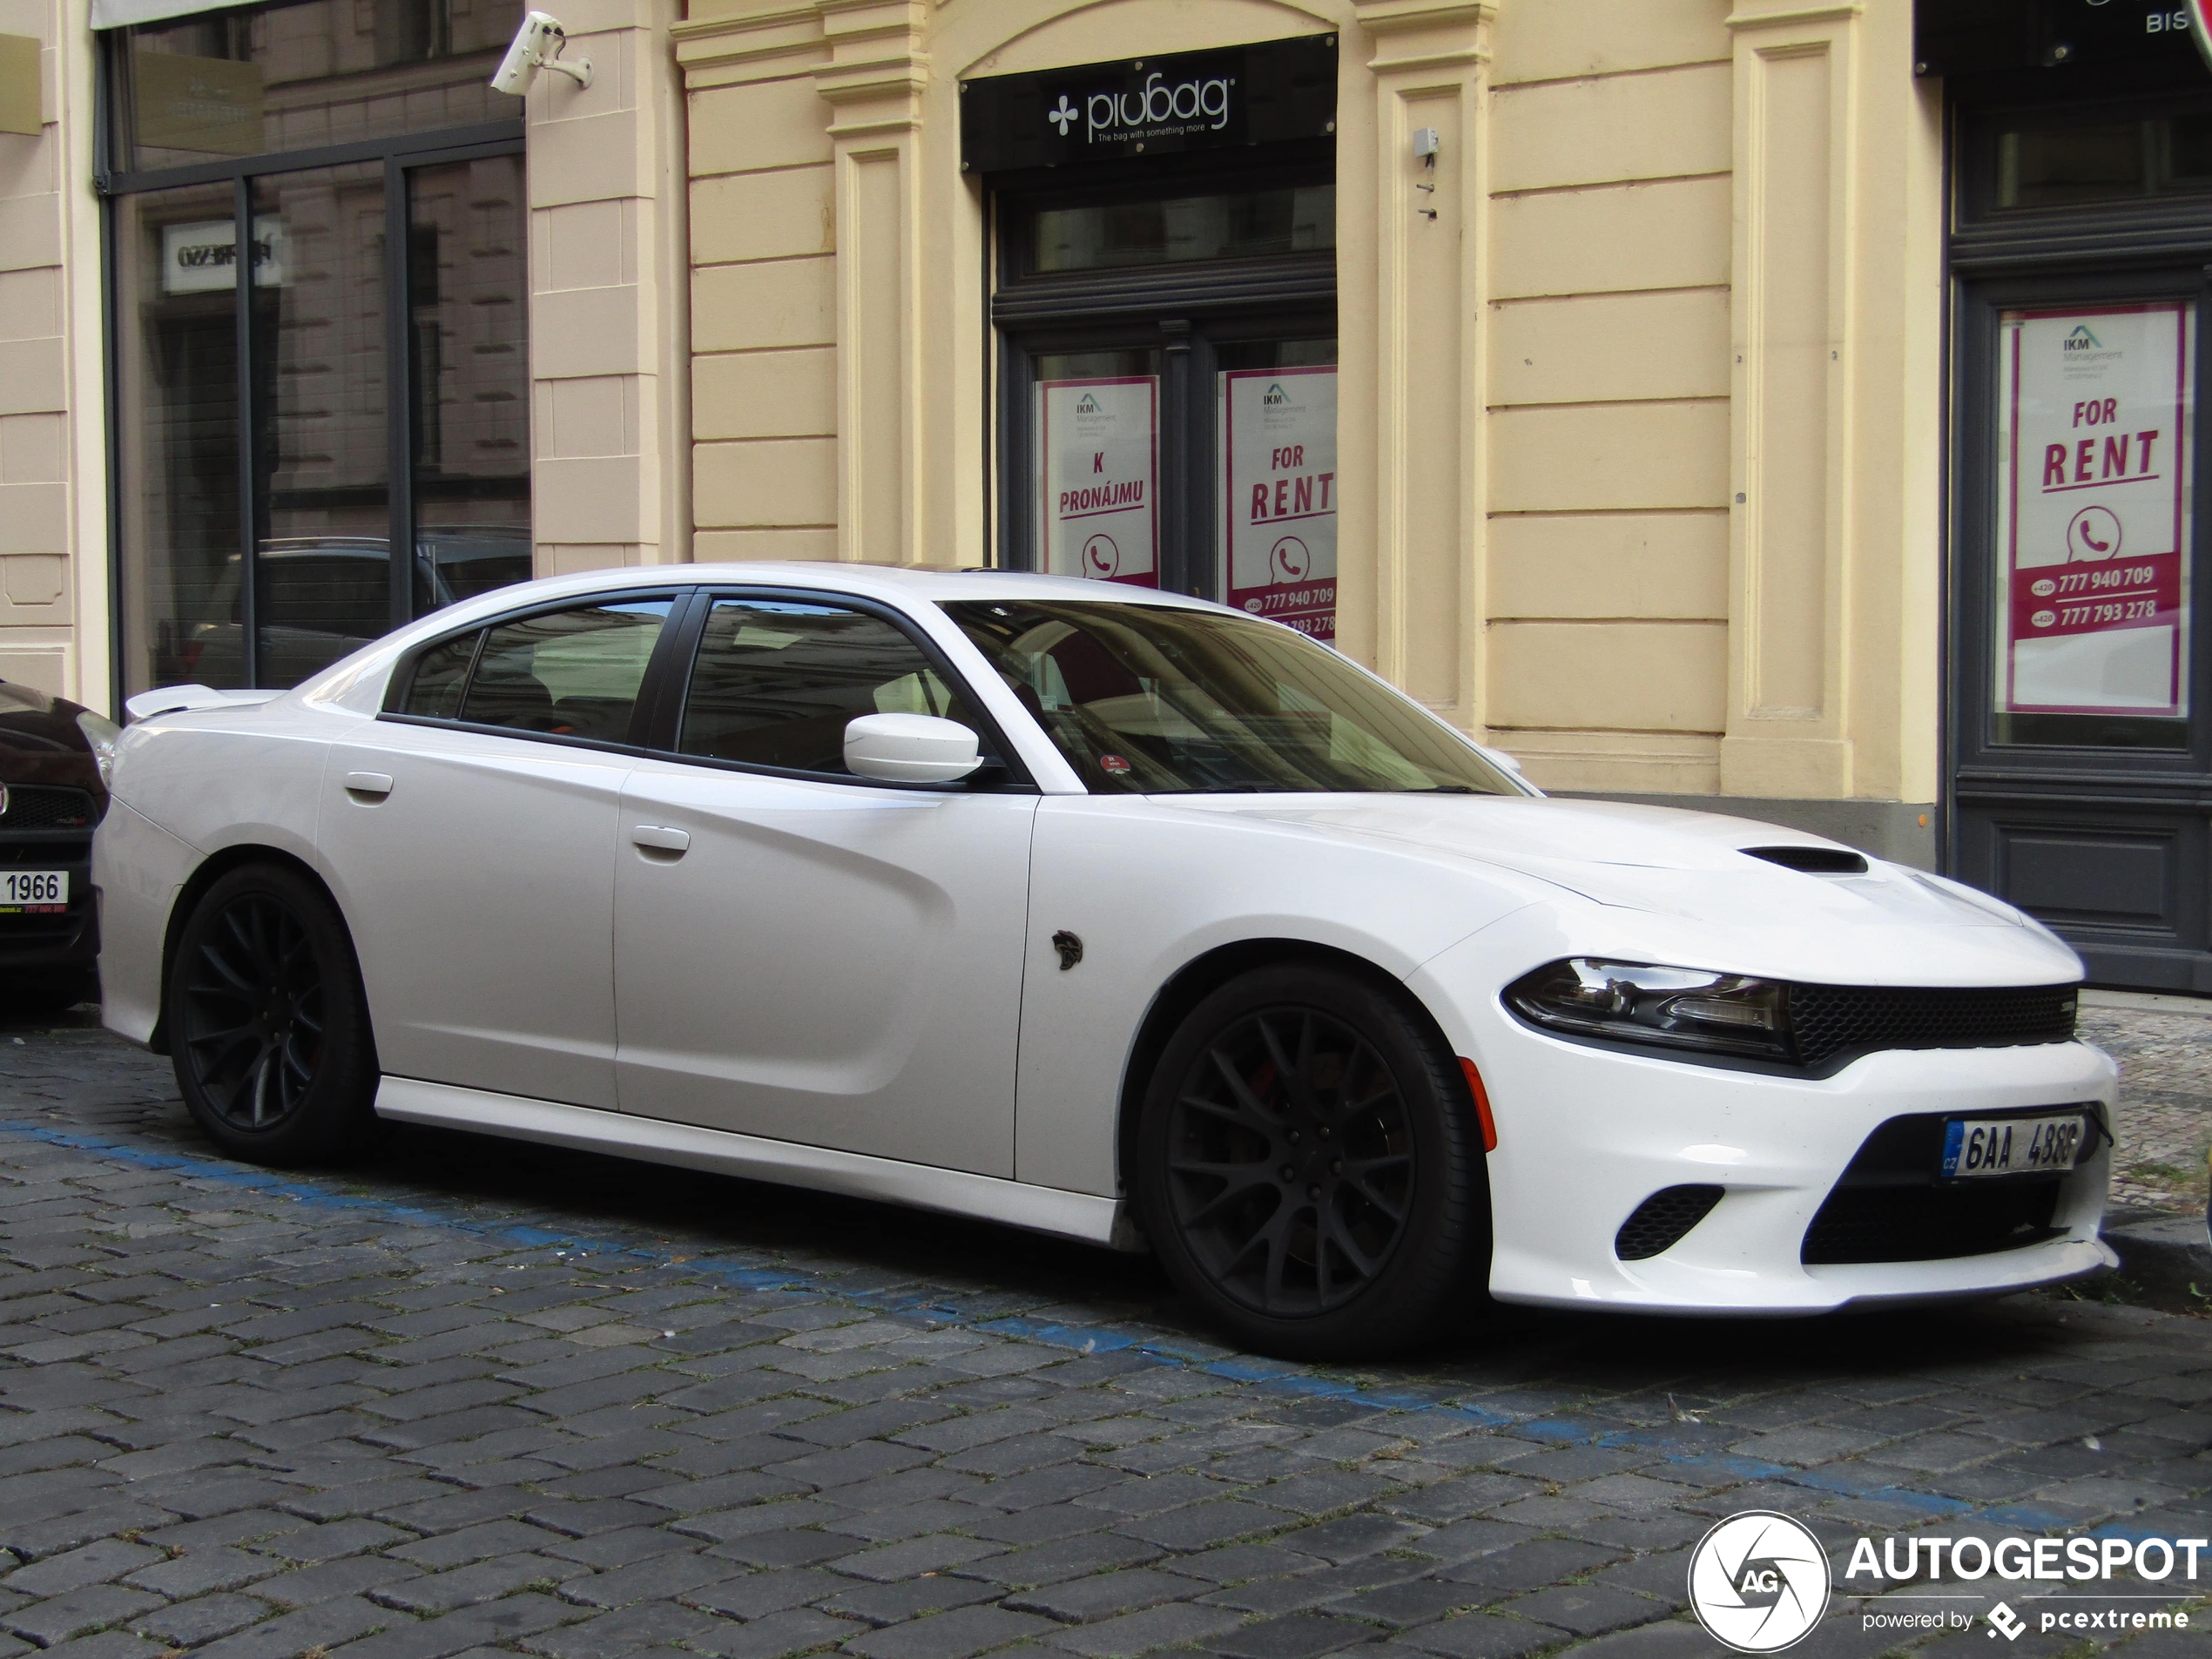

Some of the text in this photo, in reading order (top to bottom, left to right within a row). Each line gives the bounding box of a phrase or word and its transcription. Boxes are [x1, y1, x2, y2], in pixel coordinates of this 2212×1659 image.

[1098, 124, 1205, 142] The bag with something more
[2064, 338, 2089, 351] IKM
[1076, 403, 1094, 414] IKM
[1264, 395, 1282, 405] IKM
[2072, 397, 2117, 428] FOR
[1094, 452, 1103, 474] K
[1271, 444, 1305, 470] FOR
[2042, 429, 2159, 487] RENT
[1059, 480, 1143, 513] PRONÁJMU
[1251, 472, 1334, 520] RENT
[2059, 573, 2087, 592] 777
[2092, 570, 2121, 590] 940
[2123, 566, 2153, 585] 709
[1264, 593, 1286, 610] 777
[1289, 590, 1310, 606] 940
[1312, 588, 1334, 604] 709
[1313, 616, 1335, 632] 278
[2060, 606, 2091, 626] 777
[2094, 603, 2122, 623] 793
[2125, 599, 2156, 619] 278
[7, 873, 59, 900] 1966
[1966, 1126, 2012, 1169] 6AA
[1943, 1157, 1957, 1170] CZ
